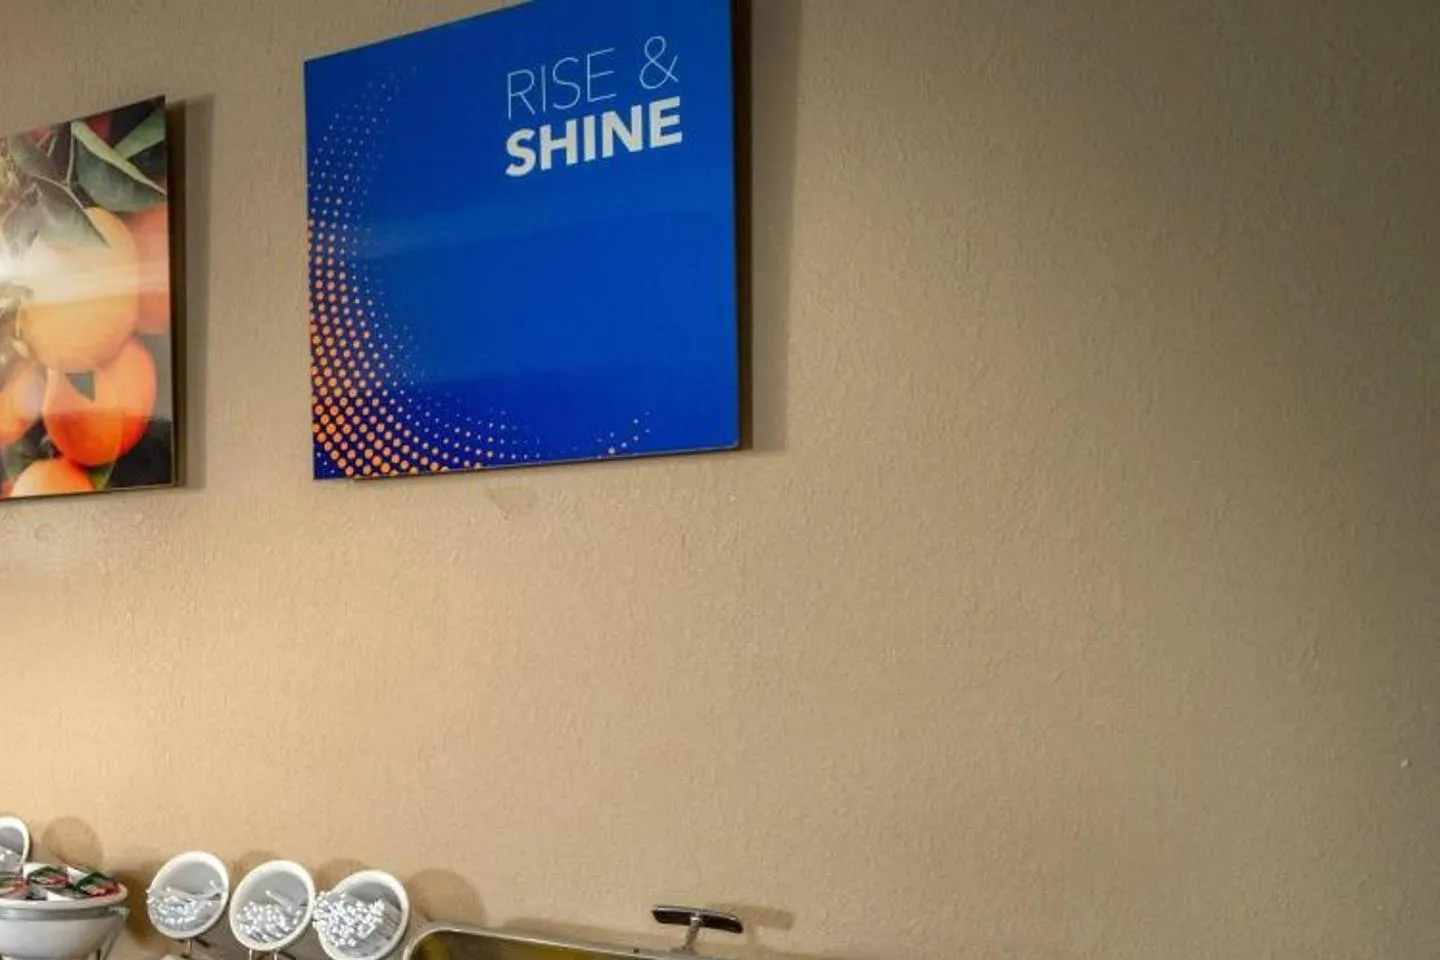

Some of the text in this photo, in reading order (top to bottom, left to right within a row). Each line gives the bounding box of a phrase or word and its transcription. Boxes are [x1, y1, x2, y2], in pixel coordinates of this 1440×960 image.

[507, 35, 679, 120] RISE &
[505, 96, 682, 177] SHINE
